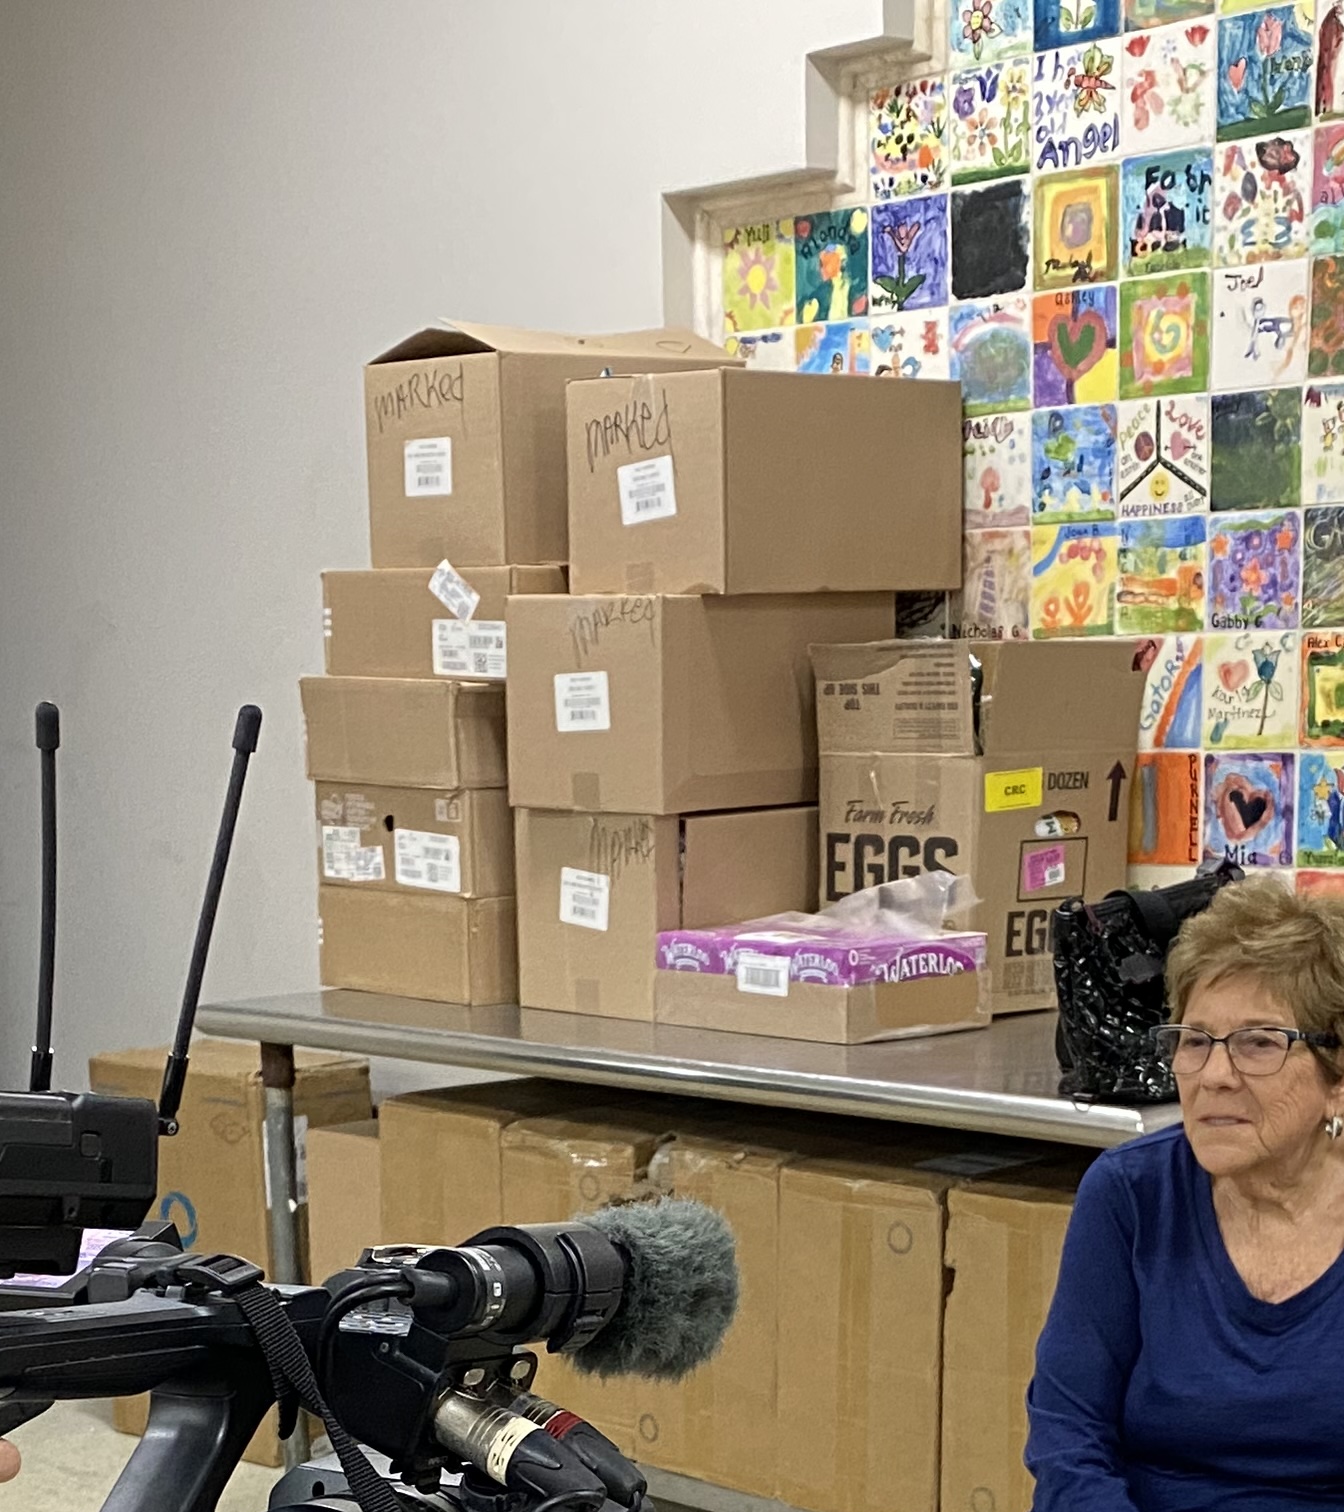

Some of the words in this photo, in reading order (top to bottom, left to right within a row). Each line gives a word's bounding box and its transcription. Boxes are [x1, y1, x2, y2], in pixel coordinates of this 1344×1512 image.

[1036, 113, 1119, 170] Angel
[1165, 399, 1205, 441] Love
[1121, 501, 1184, 517] HAPPINESS
[1211, 612, 1249, 631] Gabby
[1307, 635, 1330, 649] Alex
[1047, 771, 1089, 791] DOZEN
[844, 799, 886, 825] Farm
[888, 800, 935, 825] Fresh
[1188, 753, 1198, 863] PURNELL
[1224, 845, 1257, 867] Mia
